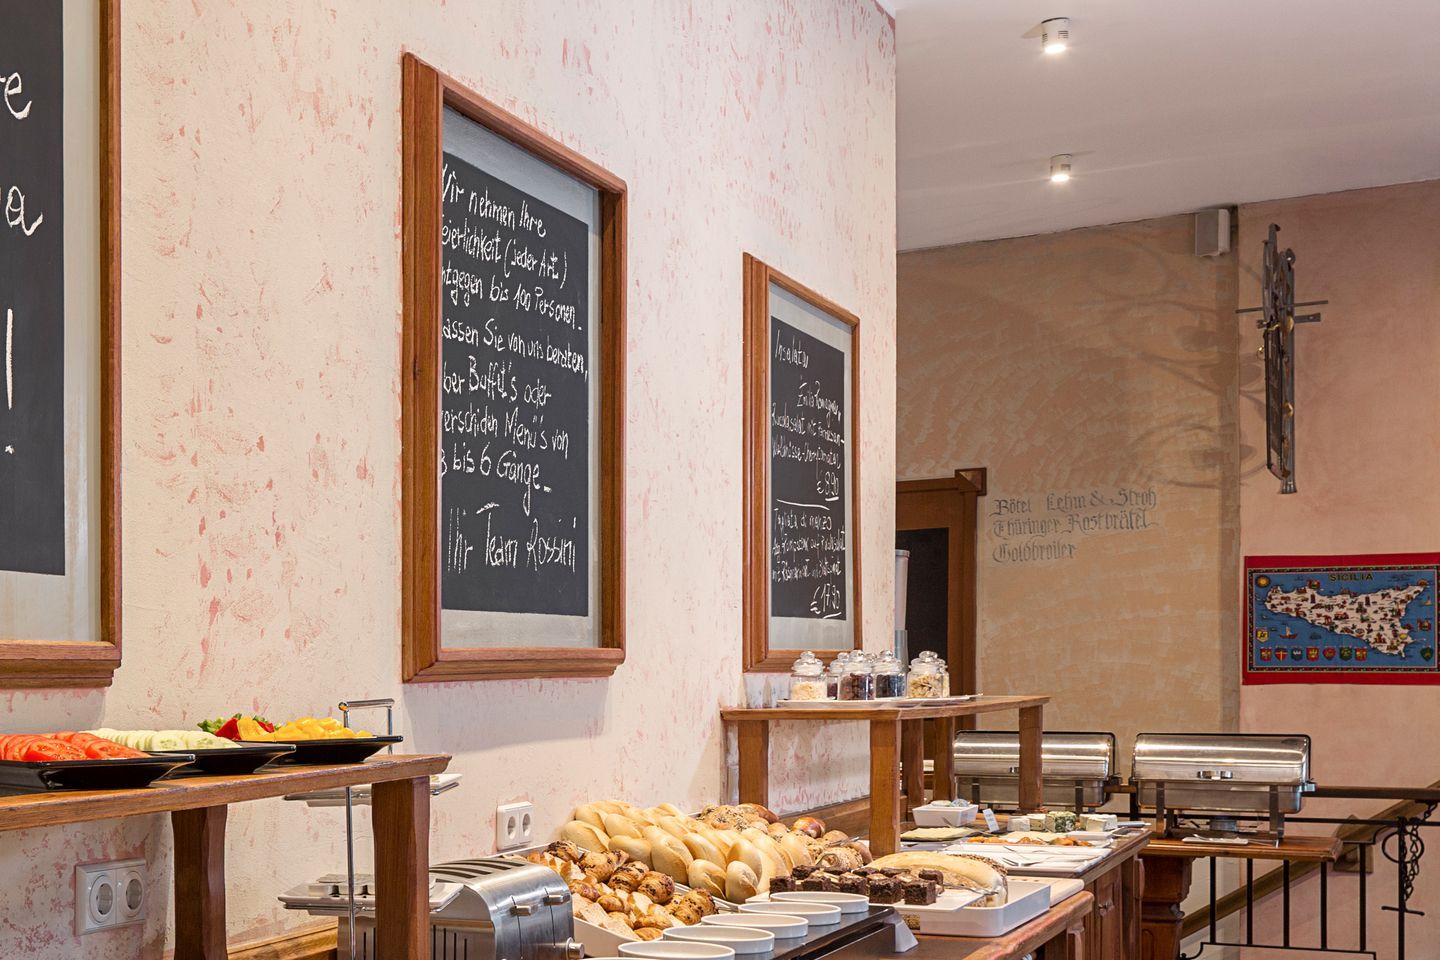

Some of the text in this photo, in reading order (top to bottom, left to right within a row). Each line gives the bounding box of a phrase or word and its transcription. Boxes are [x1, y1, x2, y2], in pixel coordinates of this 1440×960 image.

[469, 186, 515, 230] nehmen
[519, 200, 546, 238] Ihre
[442, 216, 501, 263] eierlichkeit
[442, 260, 483, 307] ntgegen
[489, 274, 509, 302] bis
[513, 283, 531, 312] 100
[442, 318, 479, 347] assen
[483, 318, 505, 351] Sie
[508, 332, 526, 358] von
[527, 340, 544, 359] uns
[443, 361, 465, 394] ber
[524, 378, 552, 409] oder
[442, 402, 498, 438] erschiden
[552, 428, 569, 460] von
[453, 442, 475, 473] bis
[480, 442, 492, 475] 6
[1046, 491, 1086, 513] Lehm
[1090, 490, 1108, 507] &
[1111, 487, 1157, 510] Stroh
[448, 502, 576, 574] Ihr Team Rossini
[993, 518, 1060, 539] Thüringer
[992, 540, 1076, 562] Goldbroiler
[1328, 573, 1374, 582] SICILIA
